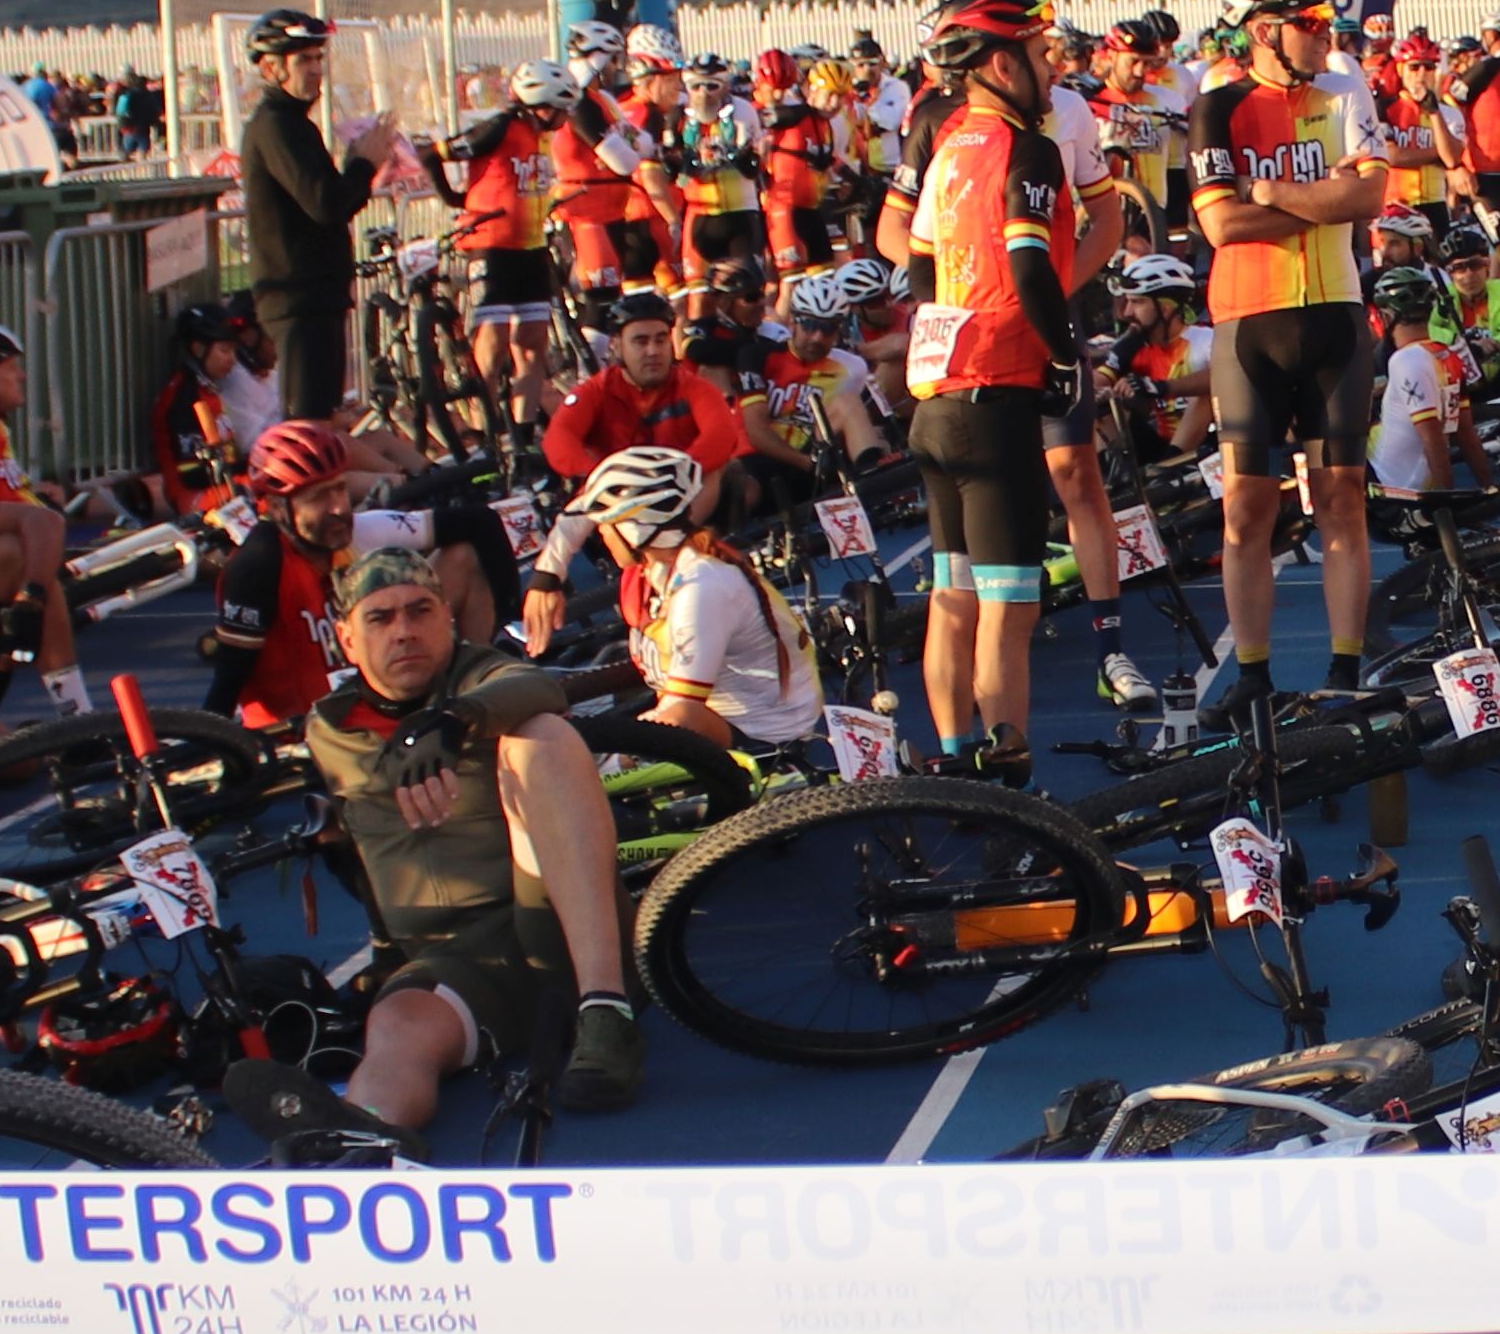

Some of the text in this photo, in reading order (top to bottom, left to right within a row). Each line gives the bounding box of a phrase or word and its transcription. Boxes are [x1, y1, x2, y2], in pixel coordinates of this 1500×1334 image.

[1470, 673, 1500, 727] 6886
[1215, 1058, 1272, 1084] ASPEN
[0, 1296, 64, 1310] reciclado
[176, 1284, 237, 1311] KM
[331, 1284, 472, 1307] 101 KM 24 H
[4, 1313, 71, 1327] reciclable
[337, 1310, 479, 1334] LA LEGIÓN
